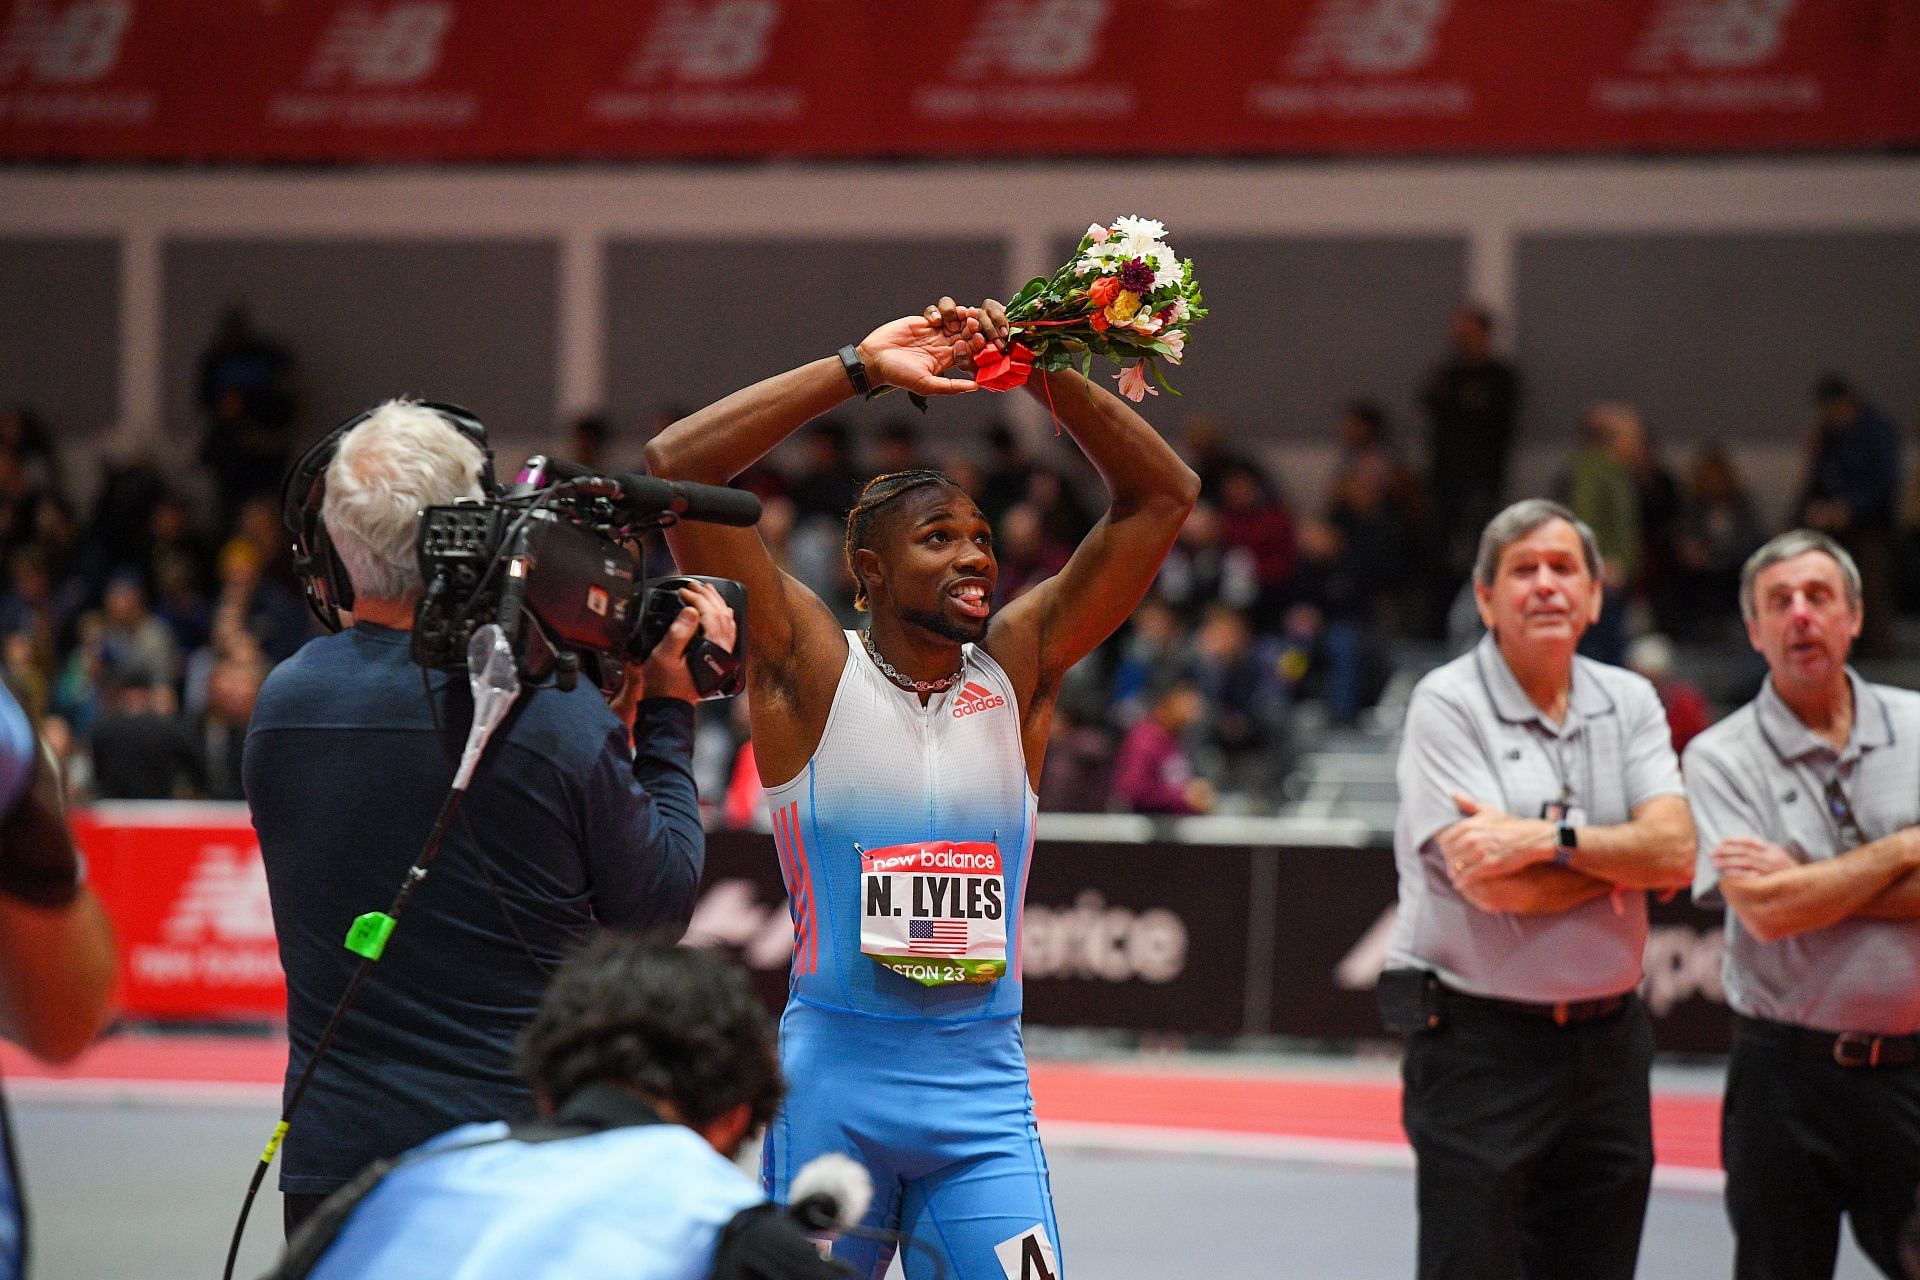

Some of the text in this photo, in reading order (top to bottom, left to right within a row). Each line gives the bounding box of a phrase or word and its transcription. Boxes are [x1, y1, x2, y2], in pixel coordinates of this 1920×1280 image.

[952, 695, 1004, 718] adidas
[873, 849, 995, 871] new balance
[867, 876, 1001, 920] N. LYLES
[881, 963, 939, 980] STON
[944, 966, 966, 981] 23
